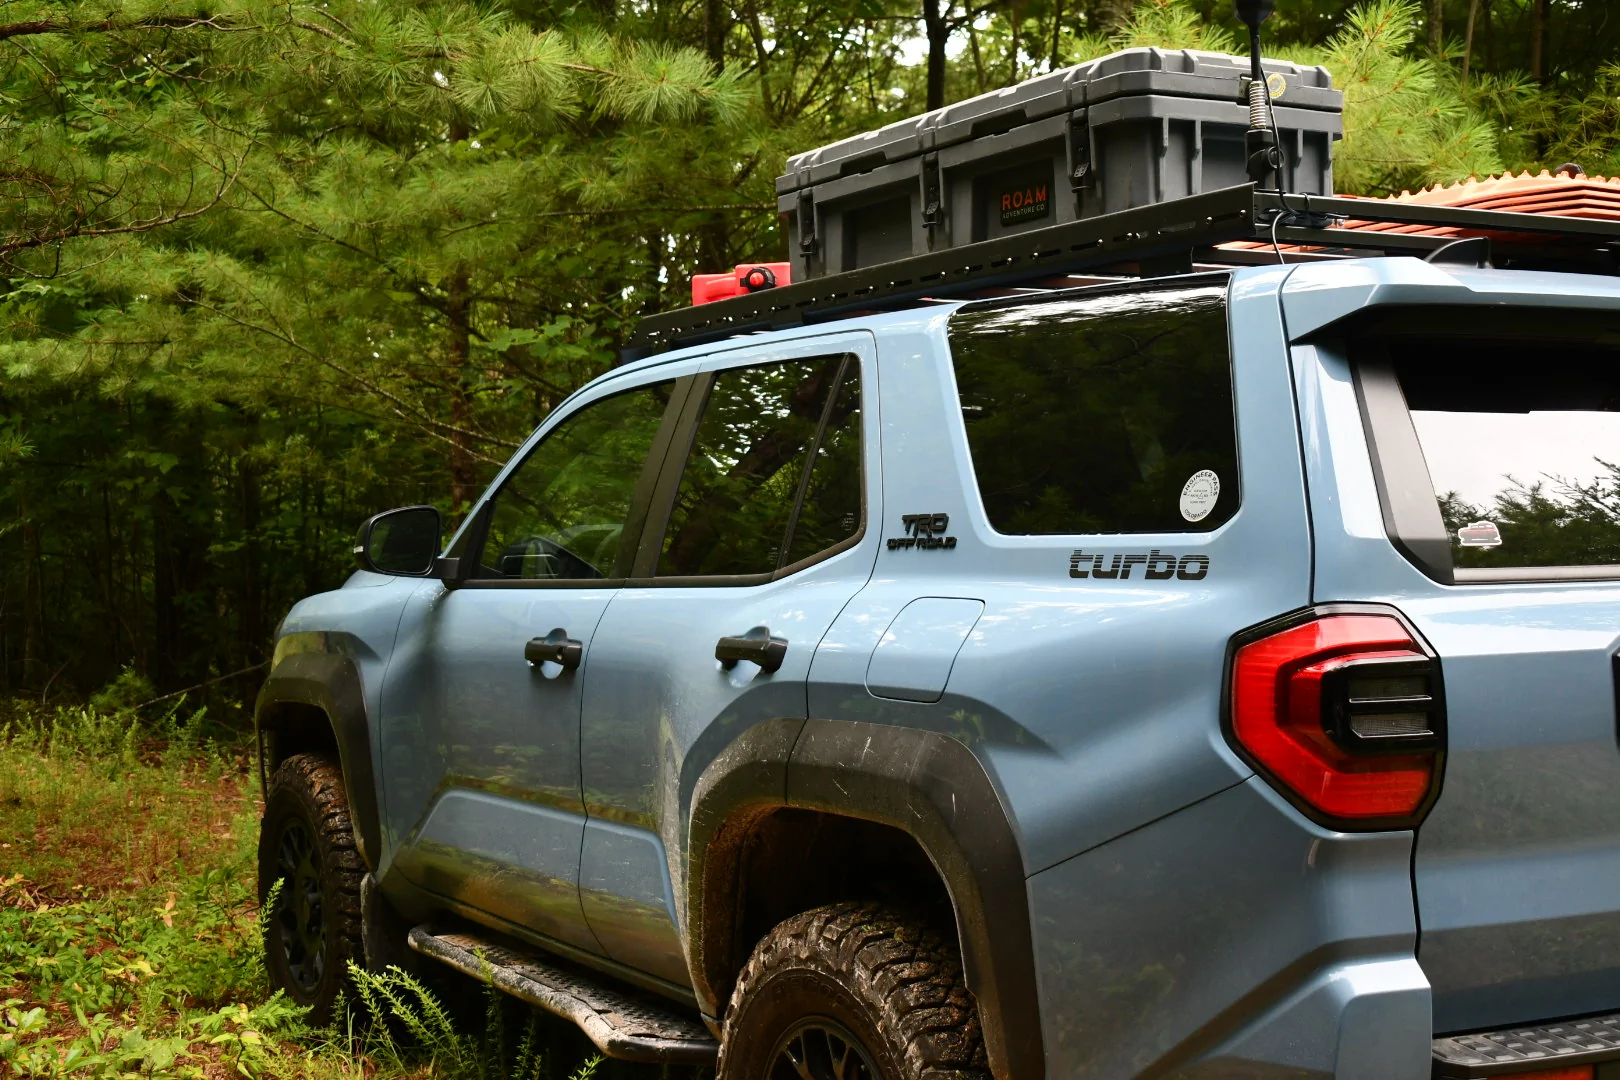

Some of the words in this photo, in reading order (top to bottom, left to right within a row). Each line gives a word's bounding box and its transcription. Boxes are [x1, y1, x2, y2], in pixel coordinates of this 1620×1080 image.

[1002, 185, 1046, 211] ROAM
[1002, 206, 1035, 219] ADVENTURE
[1183, 471, 1212, 496] ENGINEER
[901, 513, 949, 538] TRD
[1184, 508, 1208, 520] COLORADO
[887, 539, 916, 550] OFF
[916, 537, 958, 550] ROAD
[1069, 549, 1210, 581] turbo
